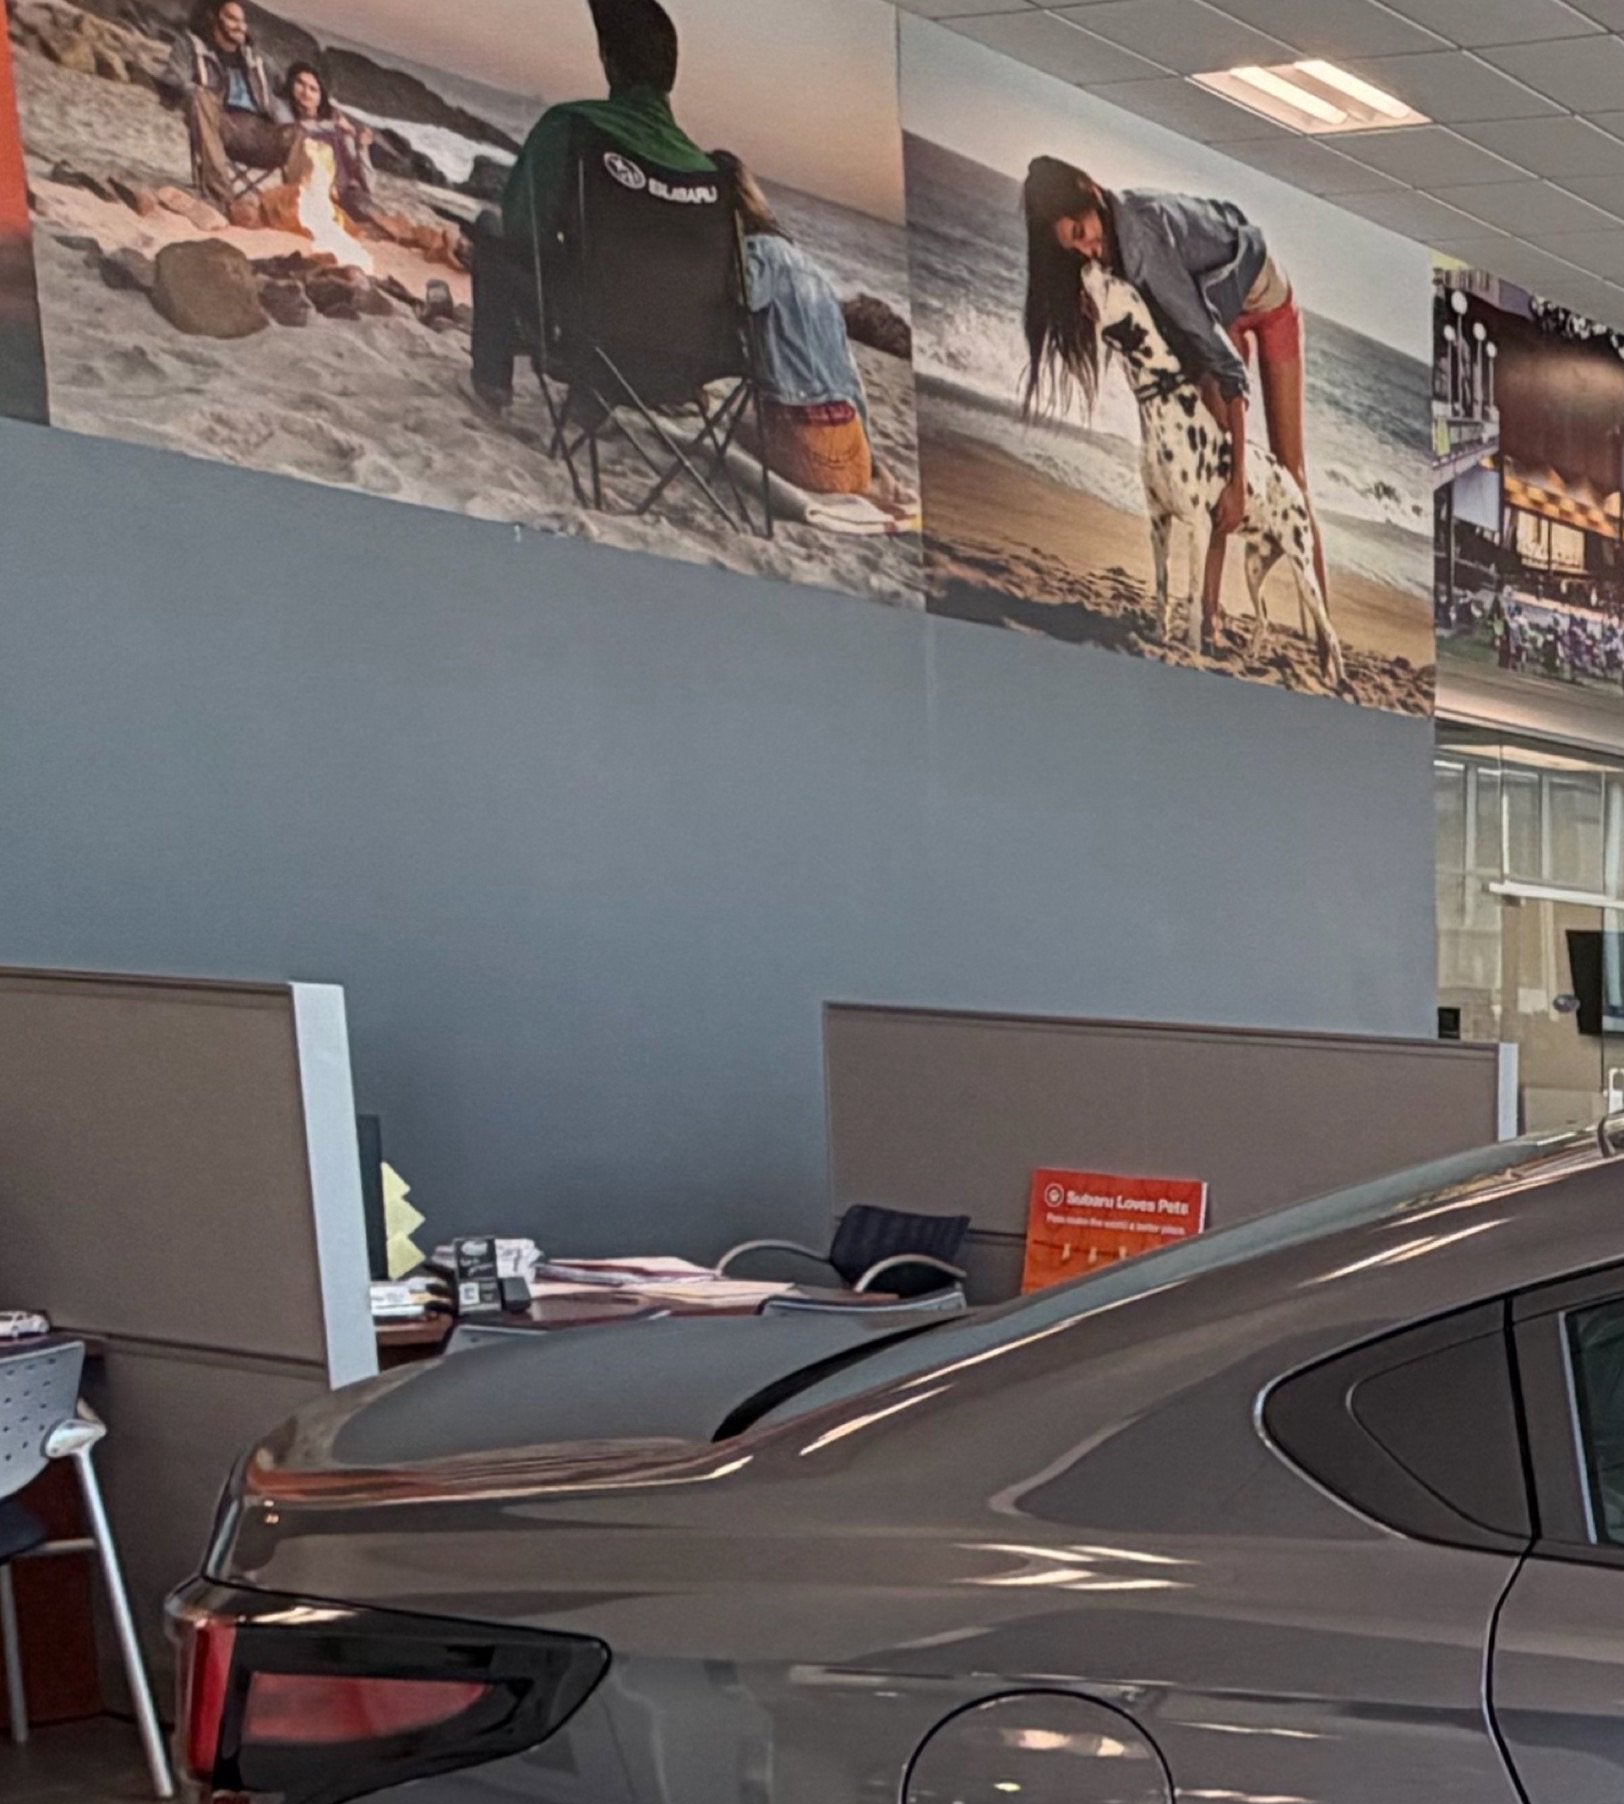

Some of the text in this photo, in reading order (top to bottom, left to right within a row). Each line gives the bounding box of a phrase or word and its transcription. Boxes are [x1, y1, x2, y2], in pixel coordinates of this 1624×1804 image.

[648, 178, 717, 204] SUBARU
[1066, 1190, 1190, 1215] Subaru Loves Pets
